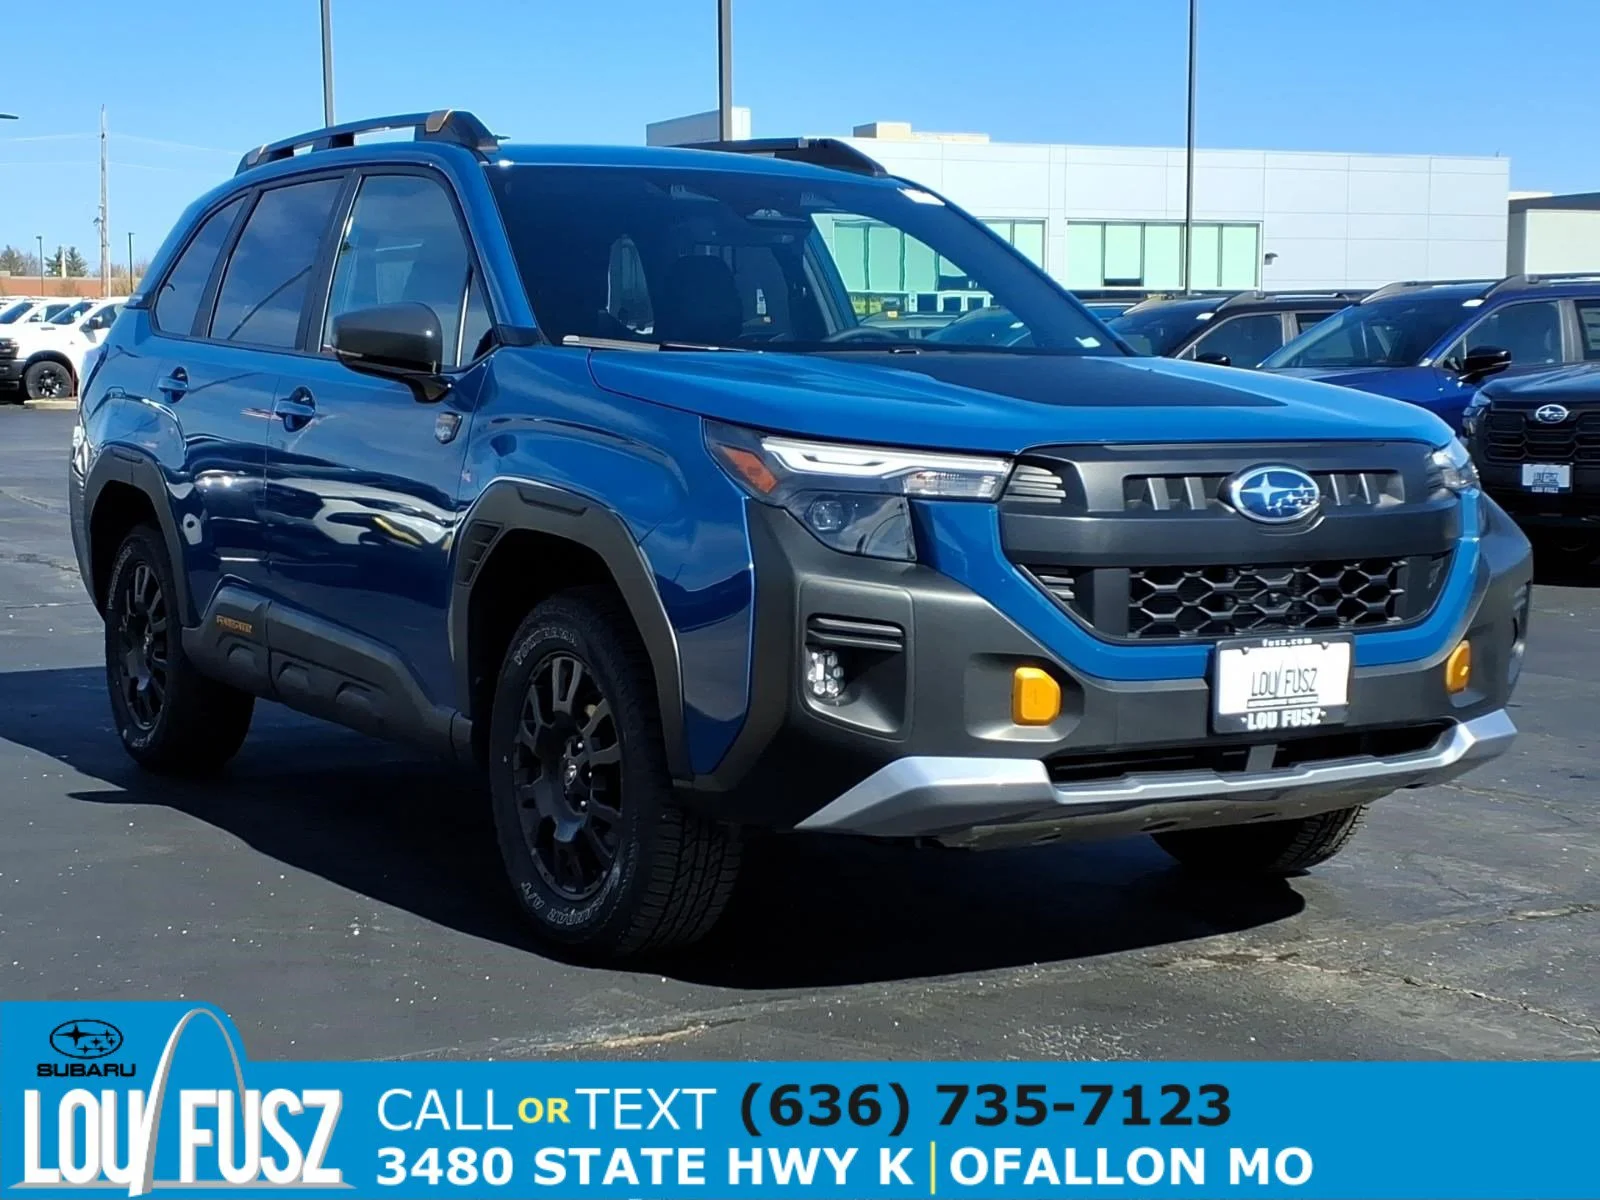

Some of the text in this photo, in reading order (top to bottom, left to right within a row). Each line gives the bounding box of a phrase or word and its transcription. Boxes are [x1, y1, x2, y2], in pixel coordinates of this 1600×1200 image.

[1251, 667, 1318, 697] LOU FUSZ
[1247, 707, 1322, 730] LOU FUSZ
